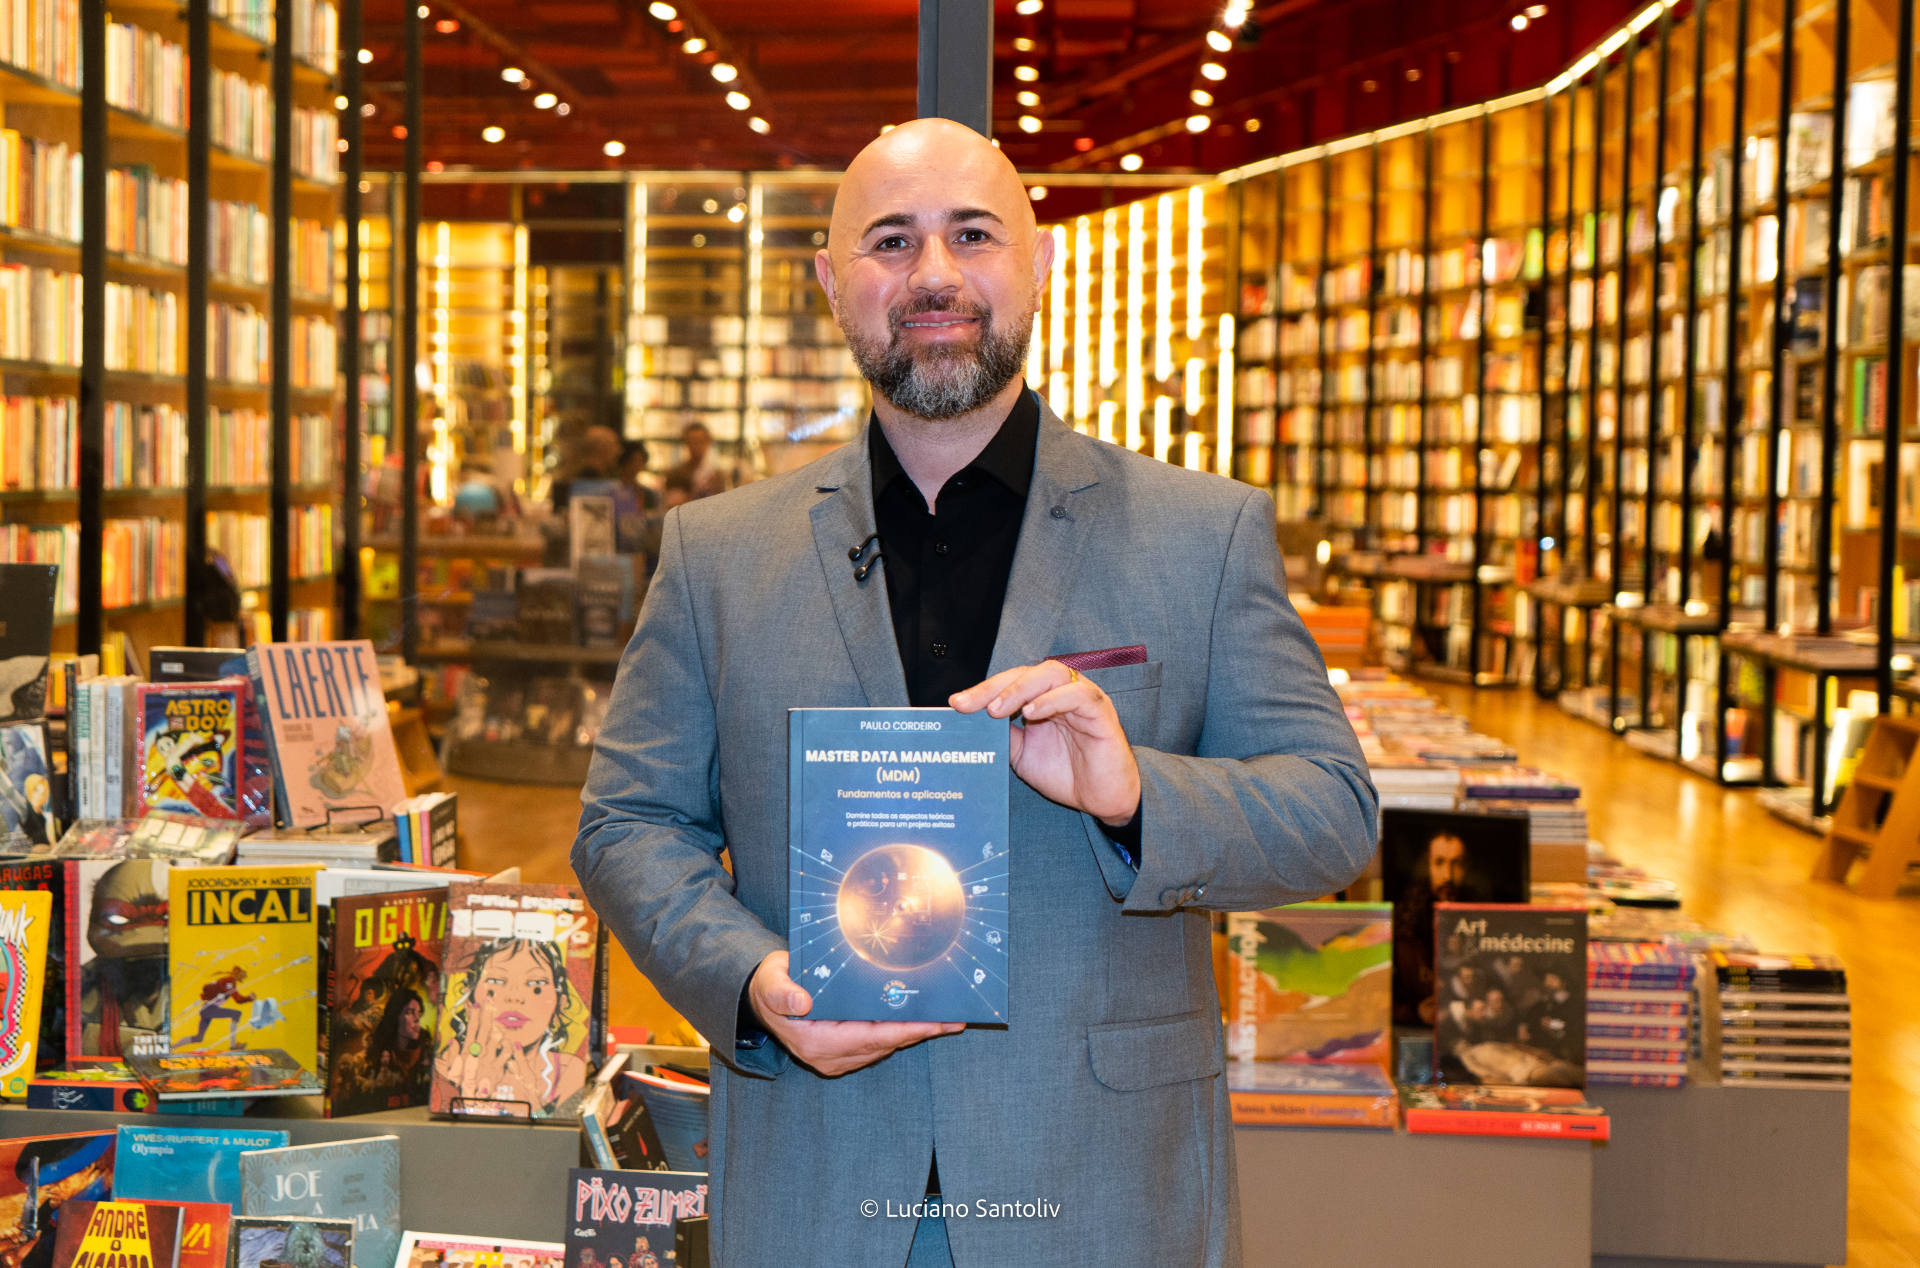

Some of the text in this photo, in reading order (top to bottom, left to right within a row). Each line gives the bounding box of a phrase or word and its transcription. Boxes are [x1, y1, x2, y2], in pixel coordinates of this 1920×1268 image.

[267, 646, 378, 719] LAERTE
[165, 699, 231, 716] ASTRO
[186, 715, 227, 731] BOY
[860, 721, 942, 731] PAULO CORDEIRO
[805, 750, 996, 764] MASTER DATA MANAGEMENT
[876, 767, 921, 784] (MDM)
[837, 789, 963, 802] Fundamentos e aplicações
[871, 812, 889, 820] todos
[899, 813, 928, 821] aspectos
[852, 820, 879, 828] práticos
[880, 821, 895, 829] para
[908, 821, 931, 829] projeto
[187, 878, 259, 888] JODOROWSKY
[191, 889, 309, 925] INCAL
[1454, 917, 1488, 936] Art
[1480, 932, 1576, 953] médecine
[133, 1044, 170, 1056] NIN
[131, 1142, 174, 1157] Olympia
[222, 1138, 230, 1146] &
[233, 1138, 271, 1147] MULOT
[271, 1170, 323, 1202] JOE
[576, 1177, 632, 1223] PIXO
[312, 1201, 323, 1215] A
[88, 1207, 147, 1239] ANDRÉ
[110, 1240, 121, 1251] O
